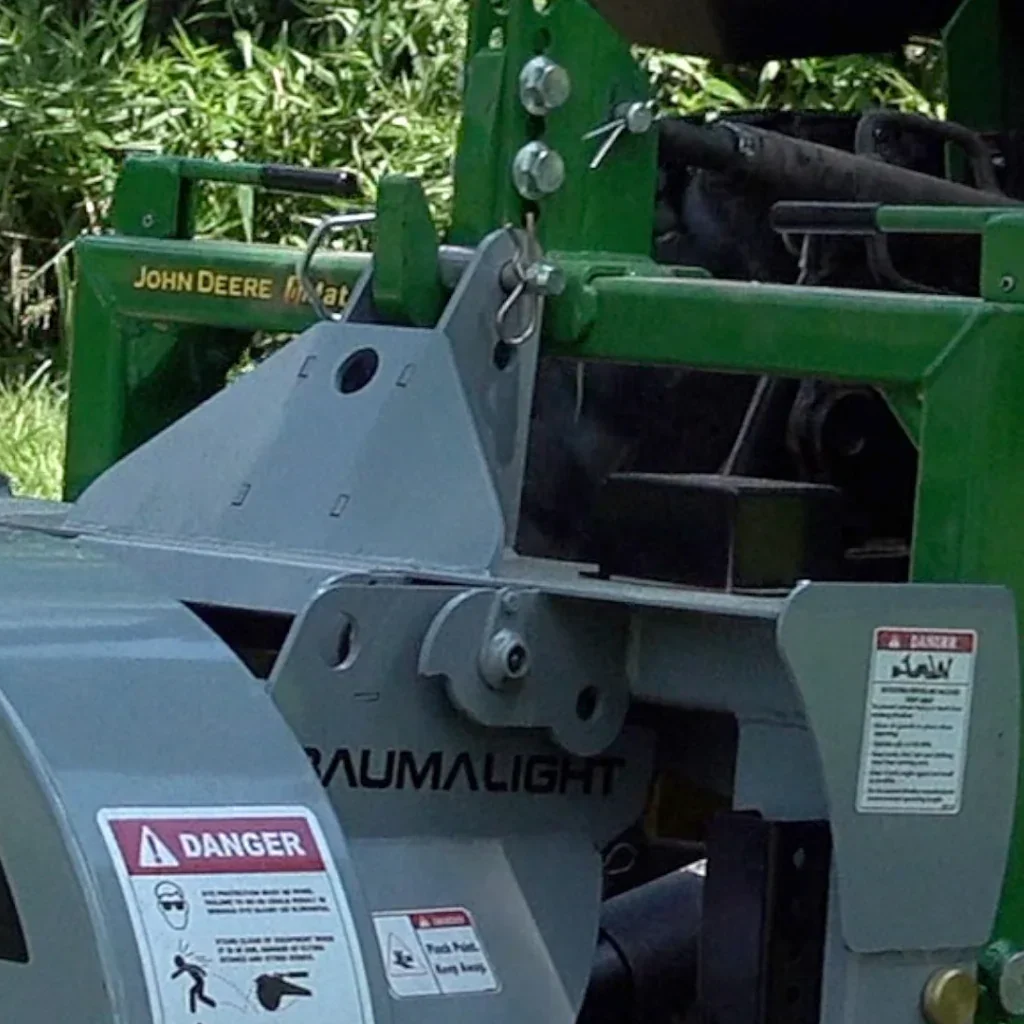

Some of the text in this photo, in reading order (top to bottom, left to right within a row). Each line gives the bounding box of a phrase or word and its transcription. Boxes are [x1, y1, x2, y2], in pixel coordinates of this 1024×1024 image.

[133, 265, 194, 292] JOHN
[197, 268, 273, 299] DEERE
[179, 831, 307, 858] DANGER
